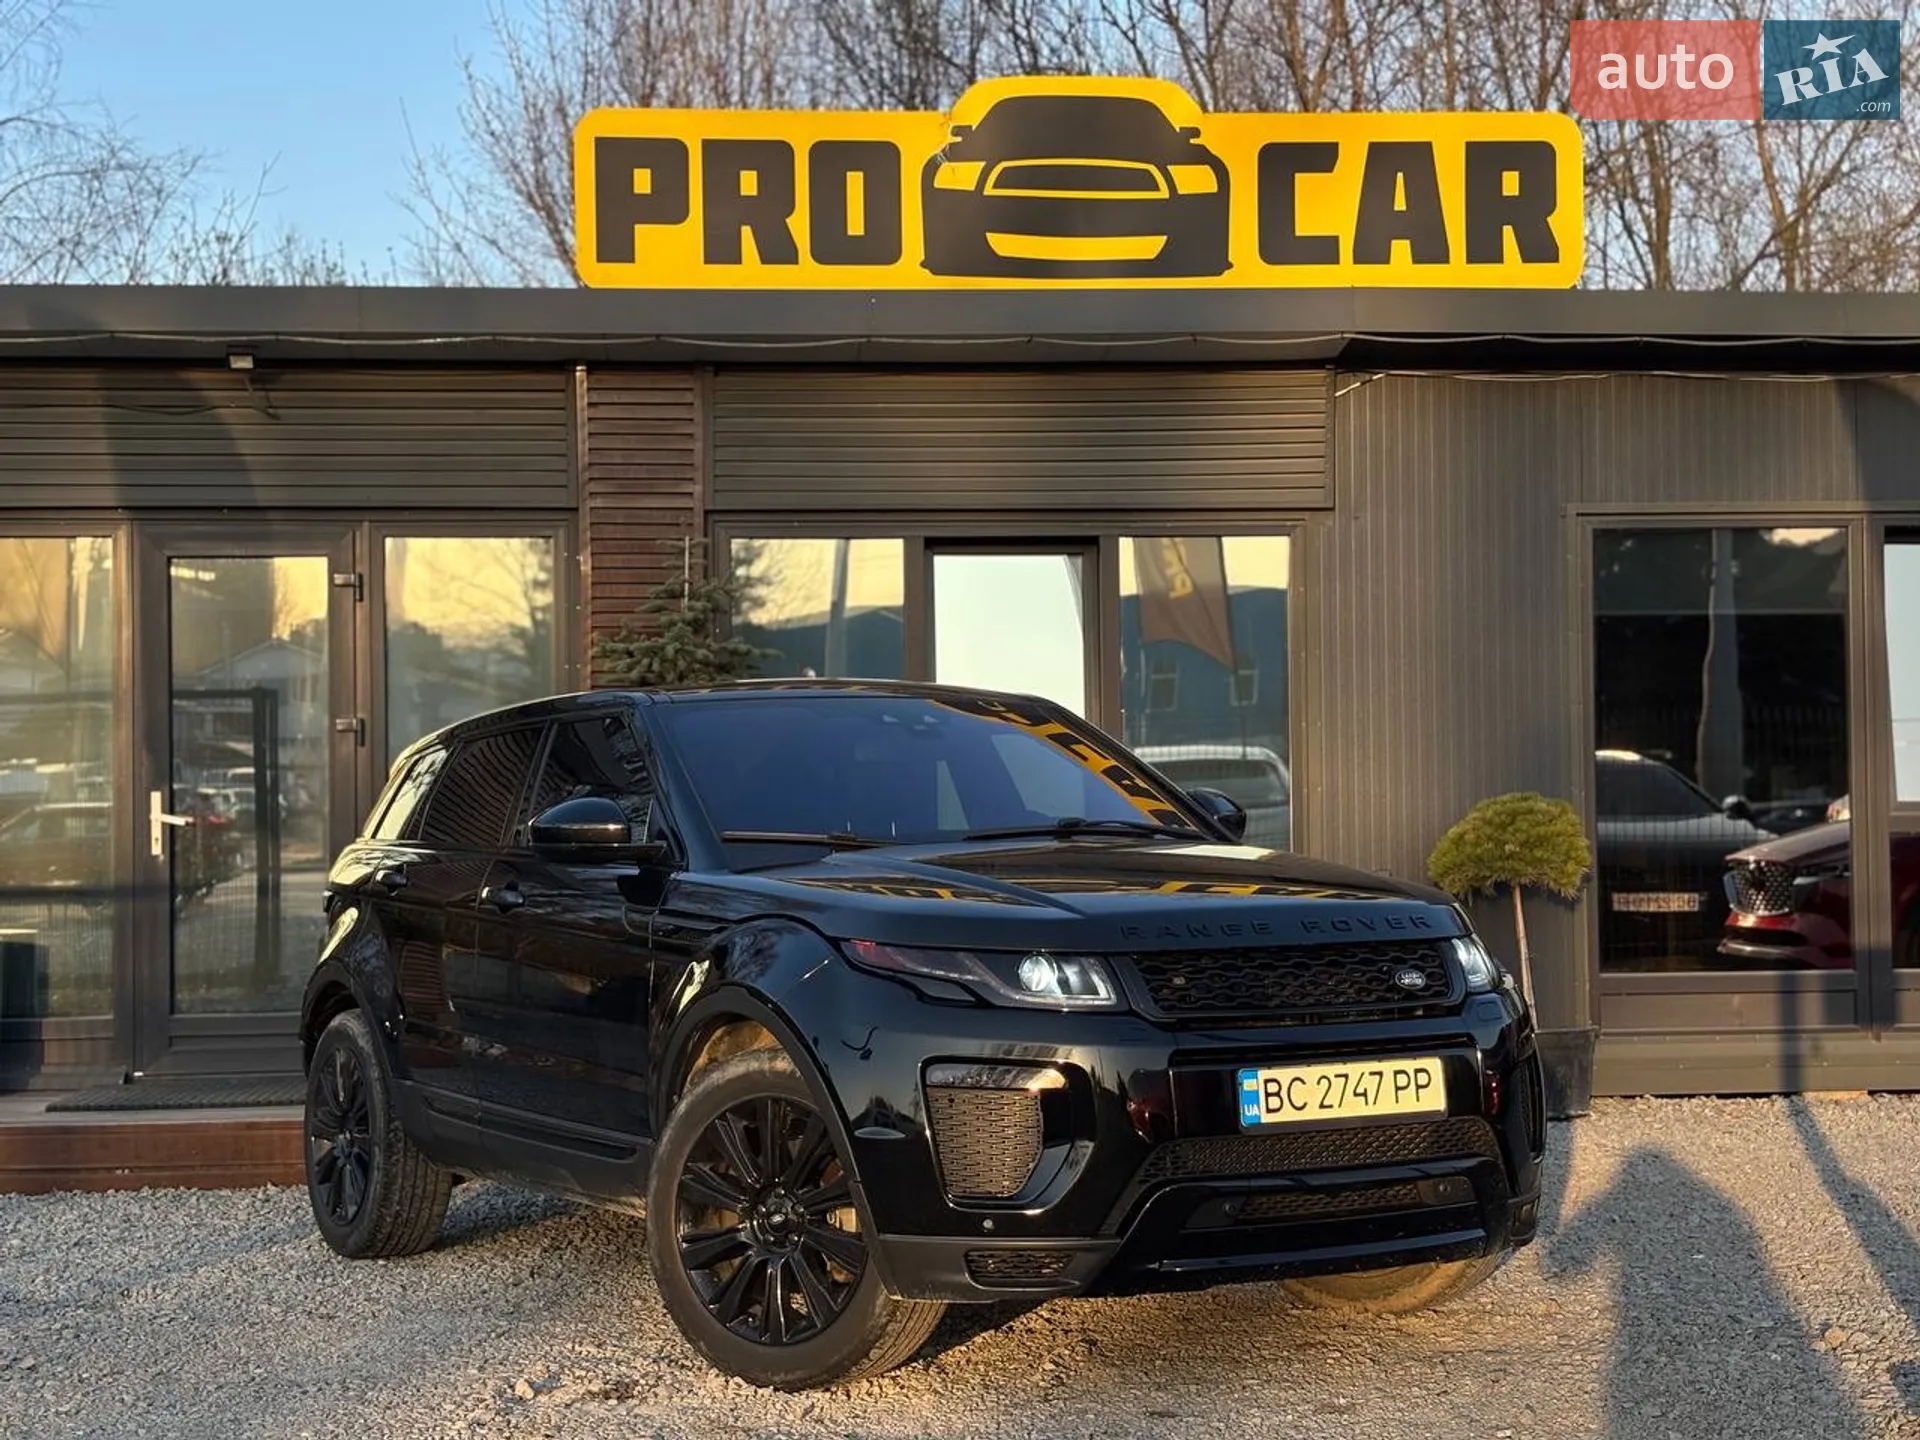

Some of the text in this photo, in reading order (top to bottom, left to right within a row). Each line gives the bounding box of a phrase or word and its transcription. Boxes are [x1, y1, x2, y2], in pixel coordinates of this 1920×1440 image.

[594, 137, 1560, 266] PRO CAR
[1120, 914, 1432, 940] RANGE ROVER
[1263, 1067, 1432, 1114] BC 2747 PP
[1244, 1104, 1260, 1117] UA
